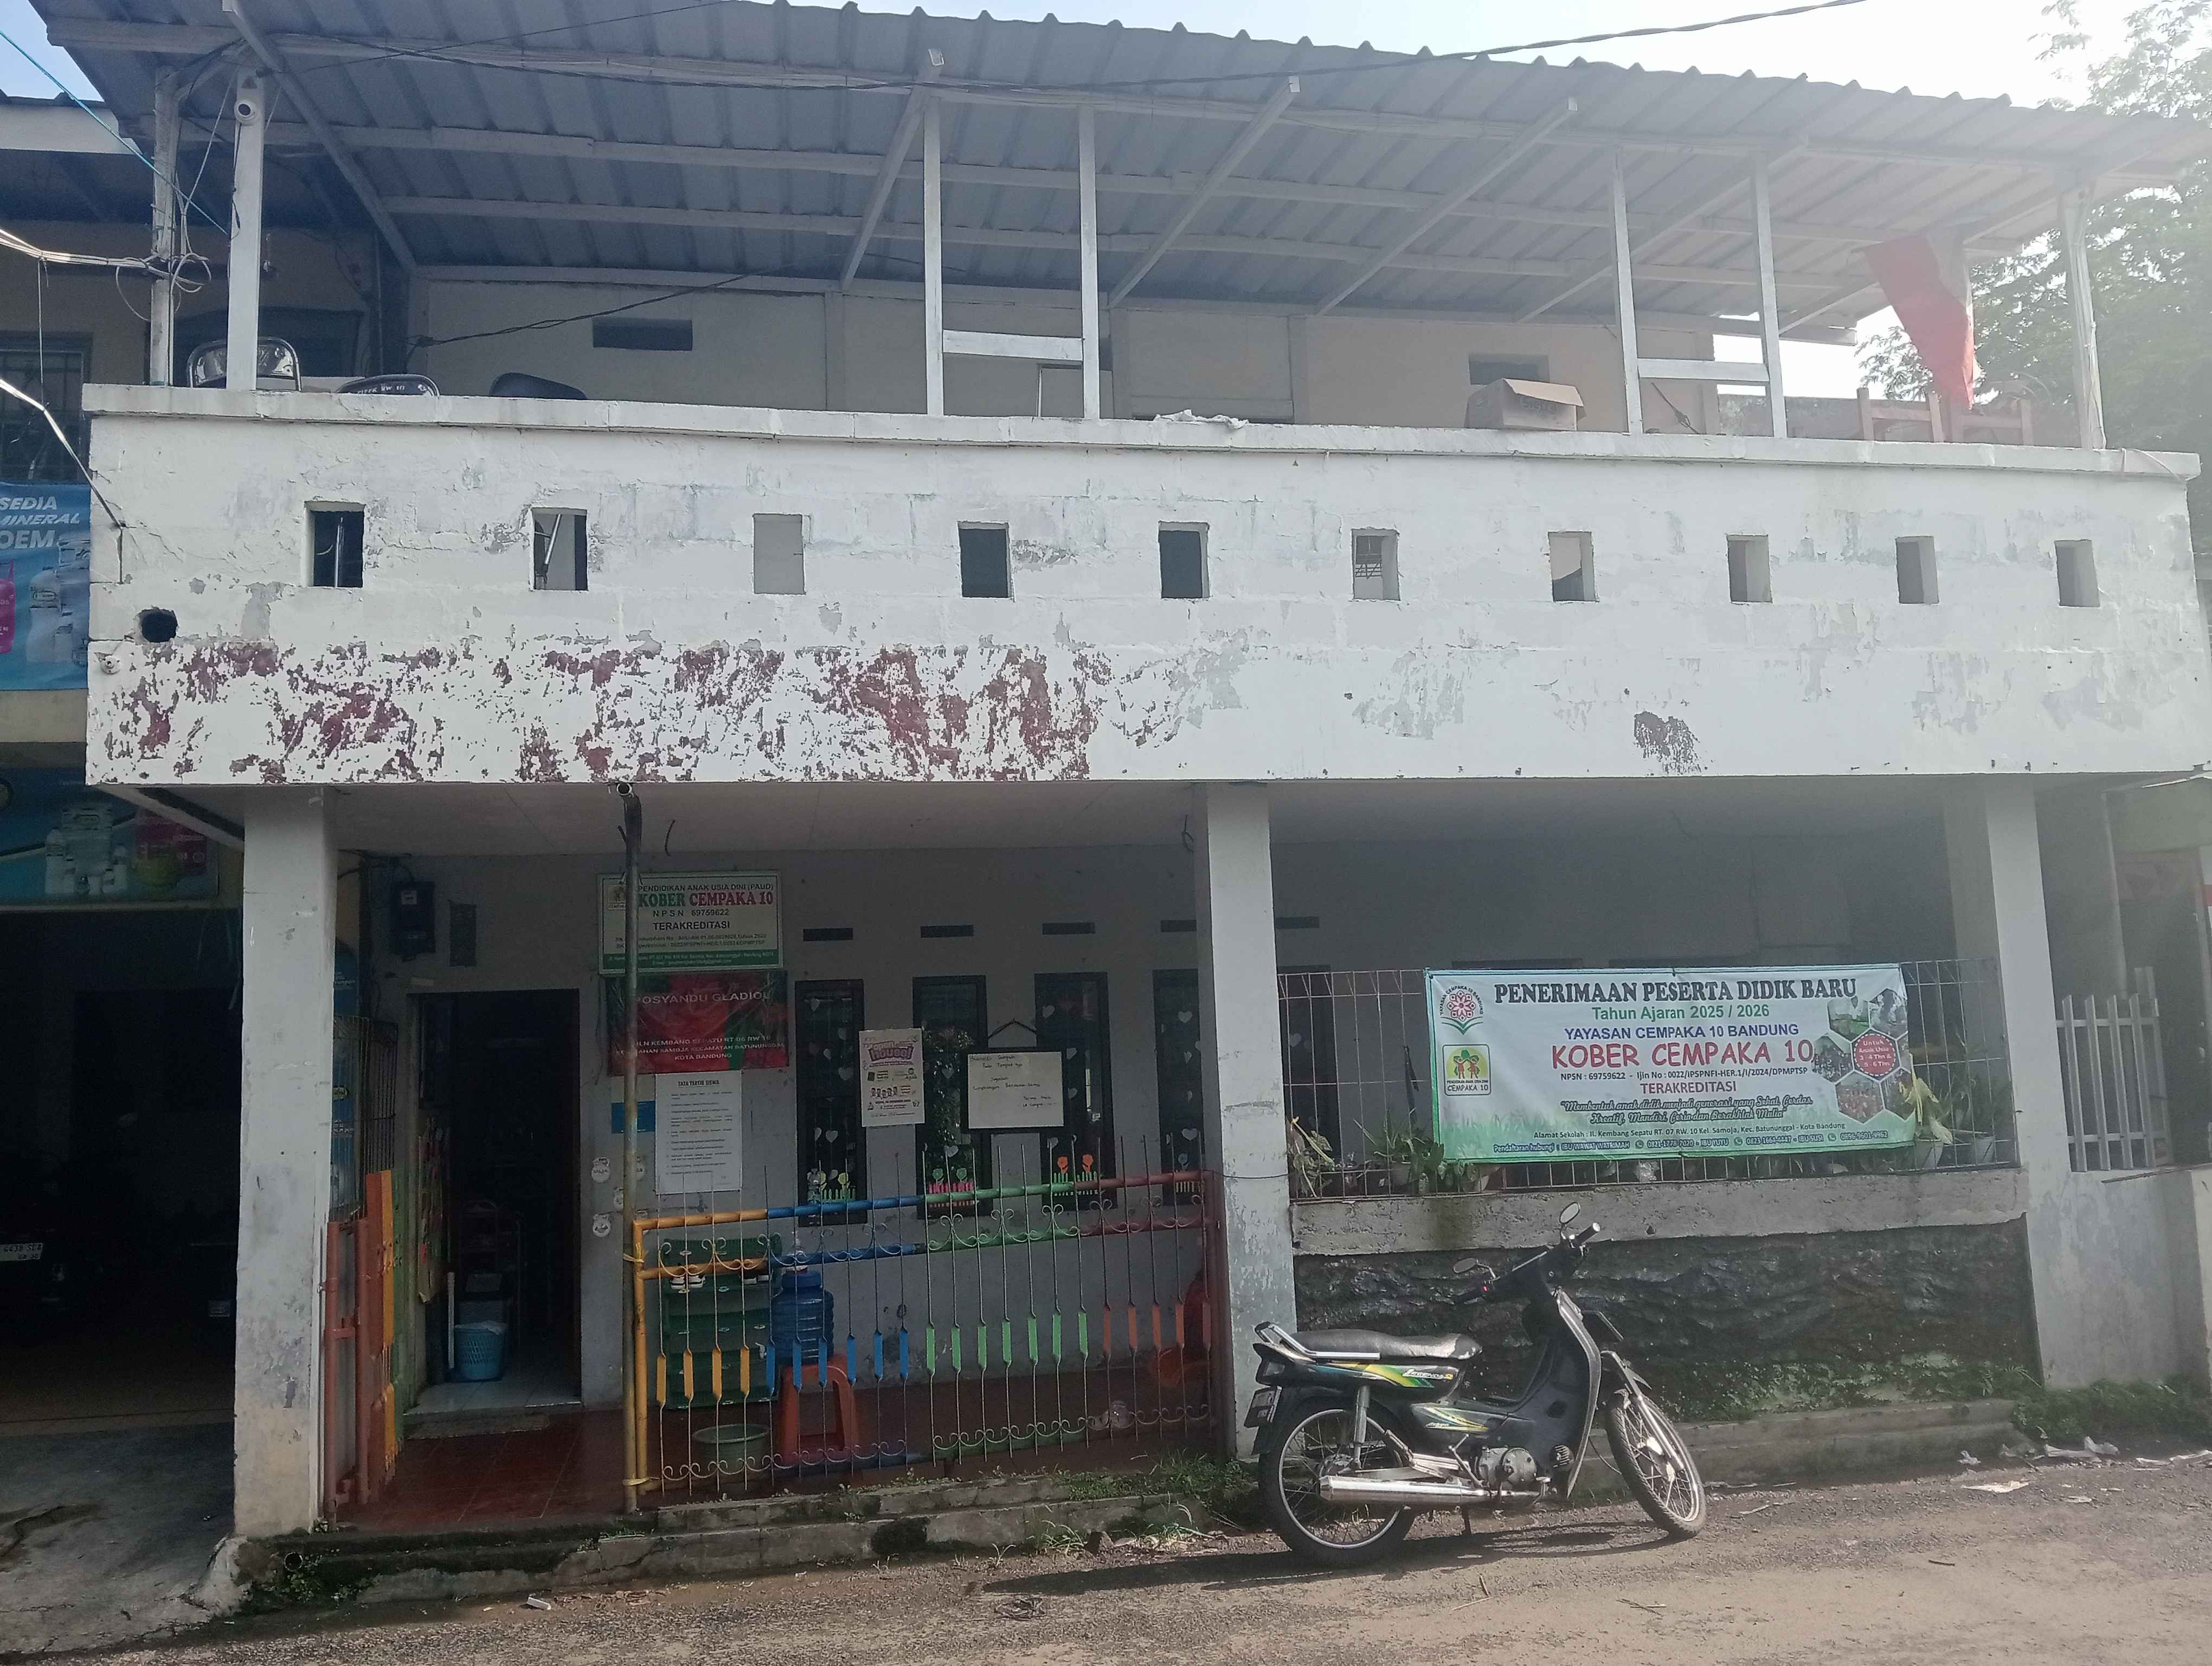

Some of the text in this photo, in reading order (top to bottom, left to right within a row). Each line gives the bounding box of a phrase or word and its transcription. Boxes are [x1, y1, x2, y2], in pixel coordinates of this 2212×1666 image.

[639, 893, 686, 907] KOBER
[689, 892, 756, 906] CEMPAKA
[759, 891, 774, 905] 10
[692, 908, 729, 917] 69759622
[653, 921, 730, 931] TERAKREDITASI
[1494, 978, 1857, 1004] PENERIMAAN PESERTA DIDIK BARU
[1592, 1004, 1770, 1022] Tahun Ajaran 2025 / 2026
[1565, 1023, 1799, 1040] YAYASAN CEMPAKA 10 BANDUNG
[1552, 1039, 1814, 1069] KOBER CEMPAKA 10
[1561, 1073, 1582, 1081] NPSN
[1589, 1072, 1626, 1080] 69759622
[1651, 1071, 1663, 1079] No
[1640, 1081, 1737, 1094] TERAKREDITASI
[1615, 1100, 1638, 1111] anak
[1639, 1098, 1661, 1110] didik
[1663, 1098, 1694, 1111] menjadi
[1695, 1097, 1732, 1112] generasi
[1733, 1099, 1756, 1112] yang
[1598, 1130, 1629, 1138] Kembang
[1816, 1122, 1846, 1130] Bandung
[1529, 1142, 1555, 1153] hubungi
[1561, 1142, 1573, 1151] IBU
